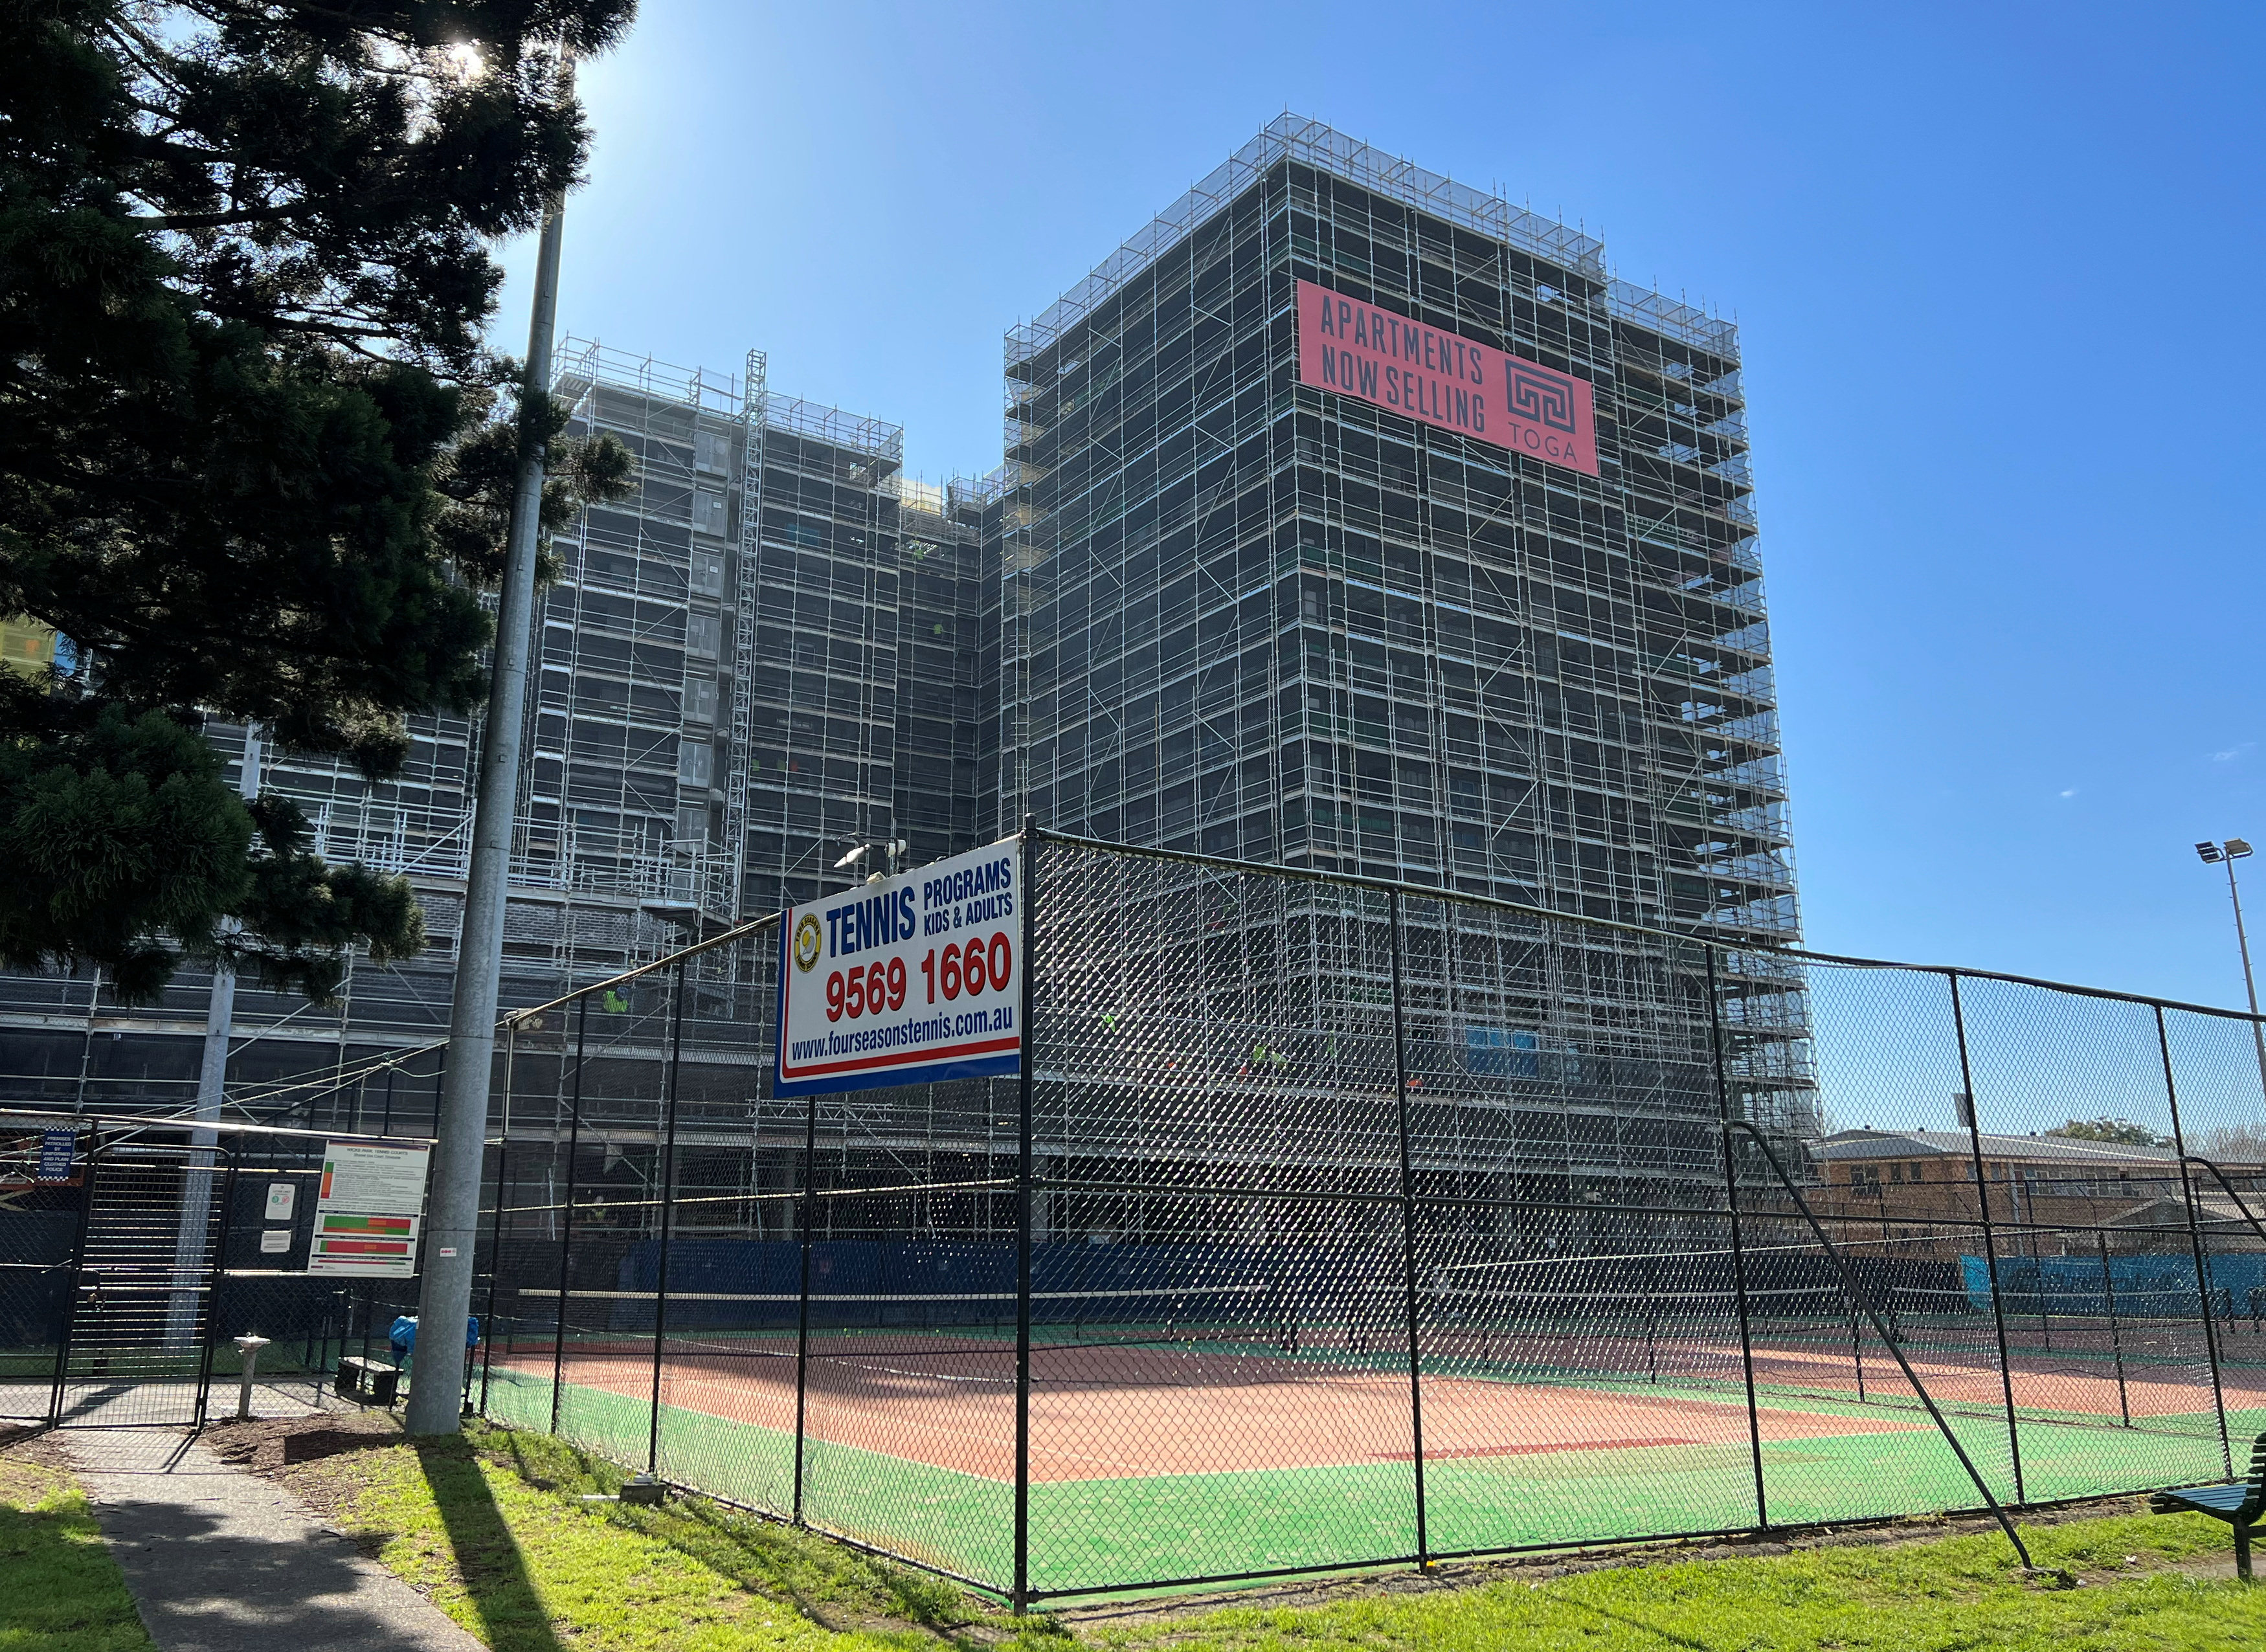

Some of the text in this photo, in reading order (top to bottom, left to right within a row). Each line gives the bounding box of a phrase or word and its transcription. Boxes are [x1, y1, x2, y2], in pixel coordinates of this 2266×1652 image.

[1321, 295, 1483, 385] APARTMENTS
[1323, 344, 1485, 432] NOW SELLING
[1509, 422, 1577, 463] TOGA
[924, 857, 1011, 911] PROGRAMS
[924, 892, 1013, 936] KIDS & ADULTS
[826, 886, 915, 957] TENNIS
[826, 932, 1012, 1022] 9569 1660
[792, 1007, 1013, 1060] www.fourseasonstennis.com.au
